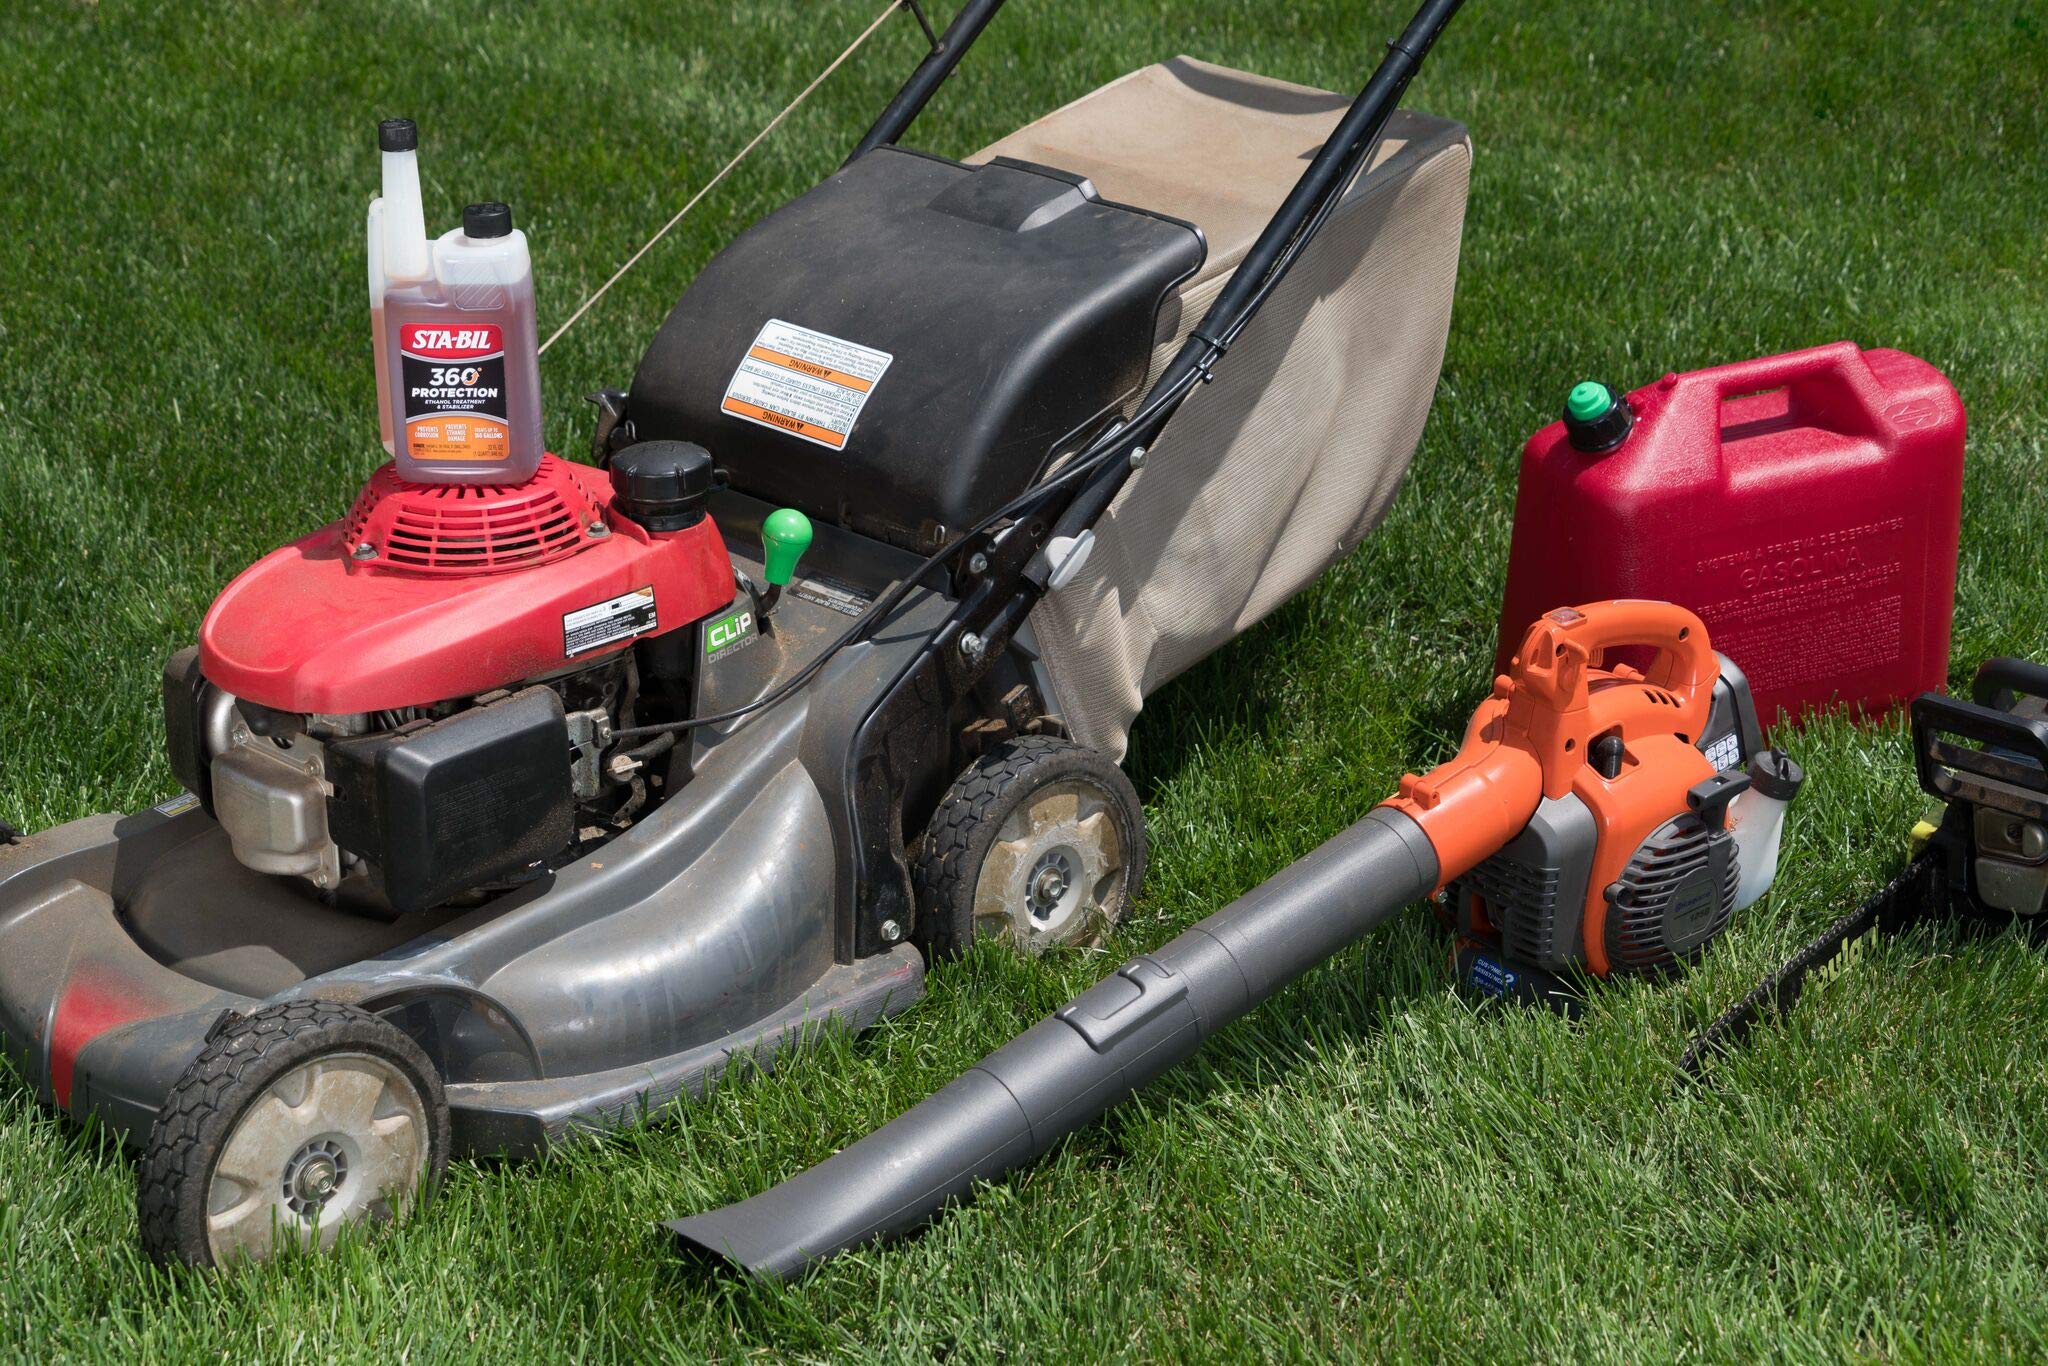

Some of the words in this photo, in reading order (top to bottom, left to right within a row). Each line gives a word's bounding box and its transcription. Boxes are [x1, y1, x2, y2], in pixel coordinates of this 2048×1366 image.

[412, 330, 491, 348] STA-BIL
[787, 358, 823, 375] WARNING
[412, 388, 498, 398] PROTECTION
[760, 411, 796, 428] WARNING
[1740, 546, 1865, 588] GASOLINA
